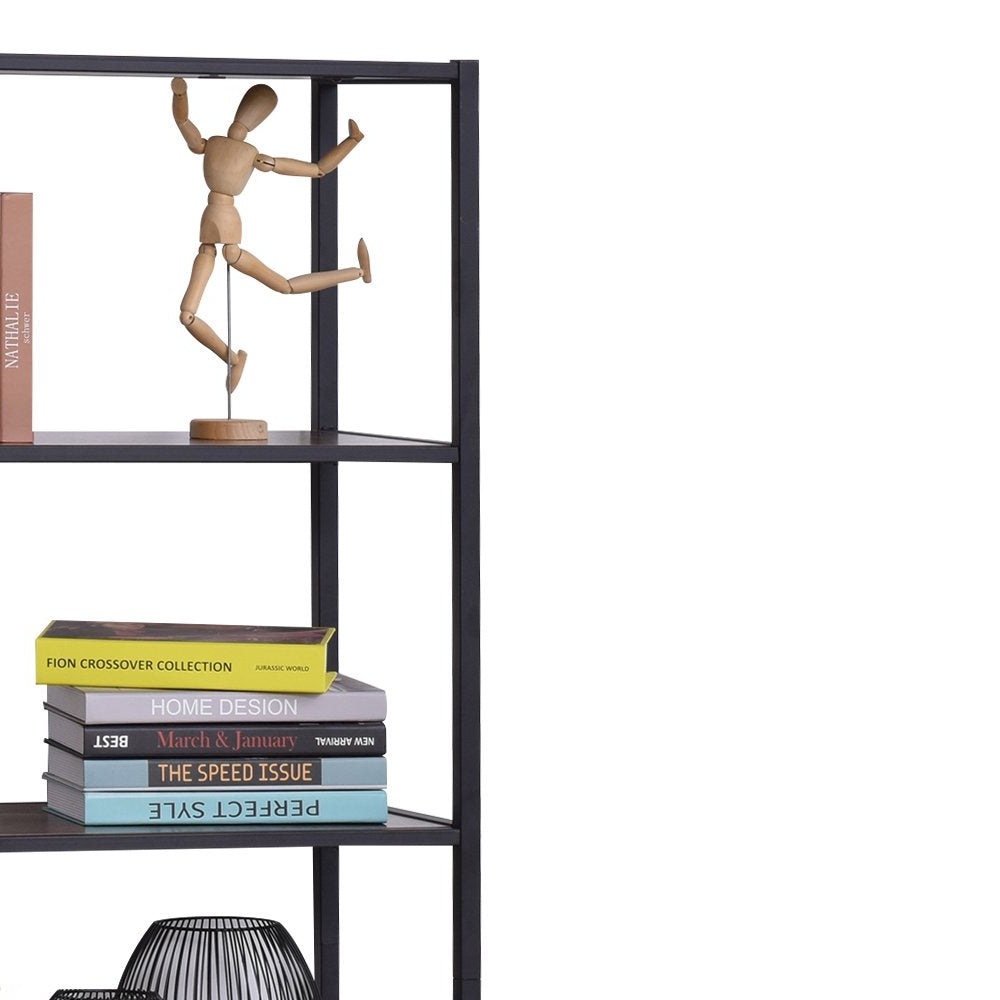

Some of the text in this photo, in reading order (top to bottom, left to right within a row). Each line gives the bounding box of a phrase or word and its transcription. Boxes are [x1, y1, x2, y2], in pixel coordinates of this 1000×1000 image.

[4, 292, 19, 369] NATHALIE
[46, 657, 233, 673] FION CROSSOVER COLLECTION
[255, 664, 285, 672] JURASSIC
[151, 698, 213, 716] HOME
[93, 735, 129, 749] BEST
[157, 729, 298, 751] March & January
[315, 736, 375, 746] NEW ARRIVAL
[158, 763, 313, 782] THE SPEED ISSUE
[149, 799, 321, 820] PERFECT SYLE
